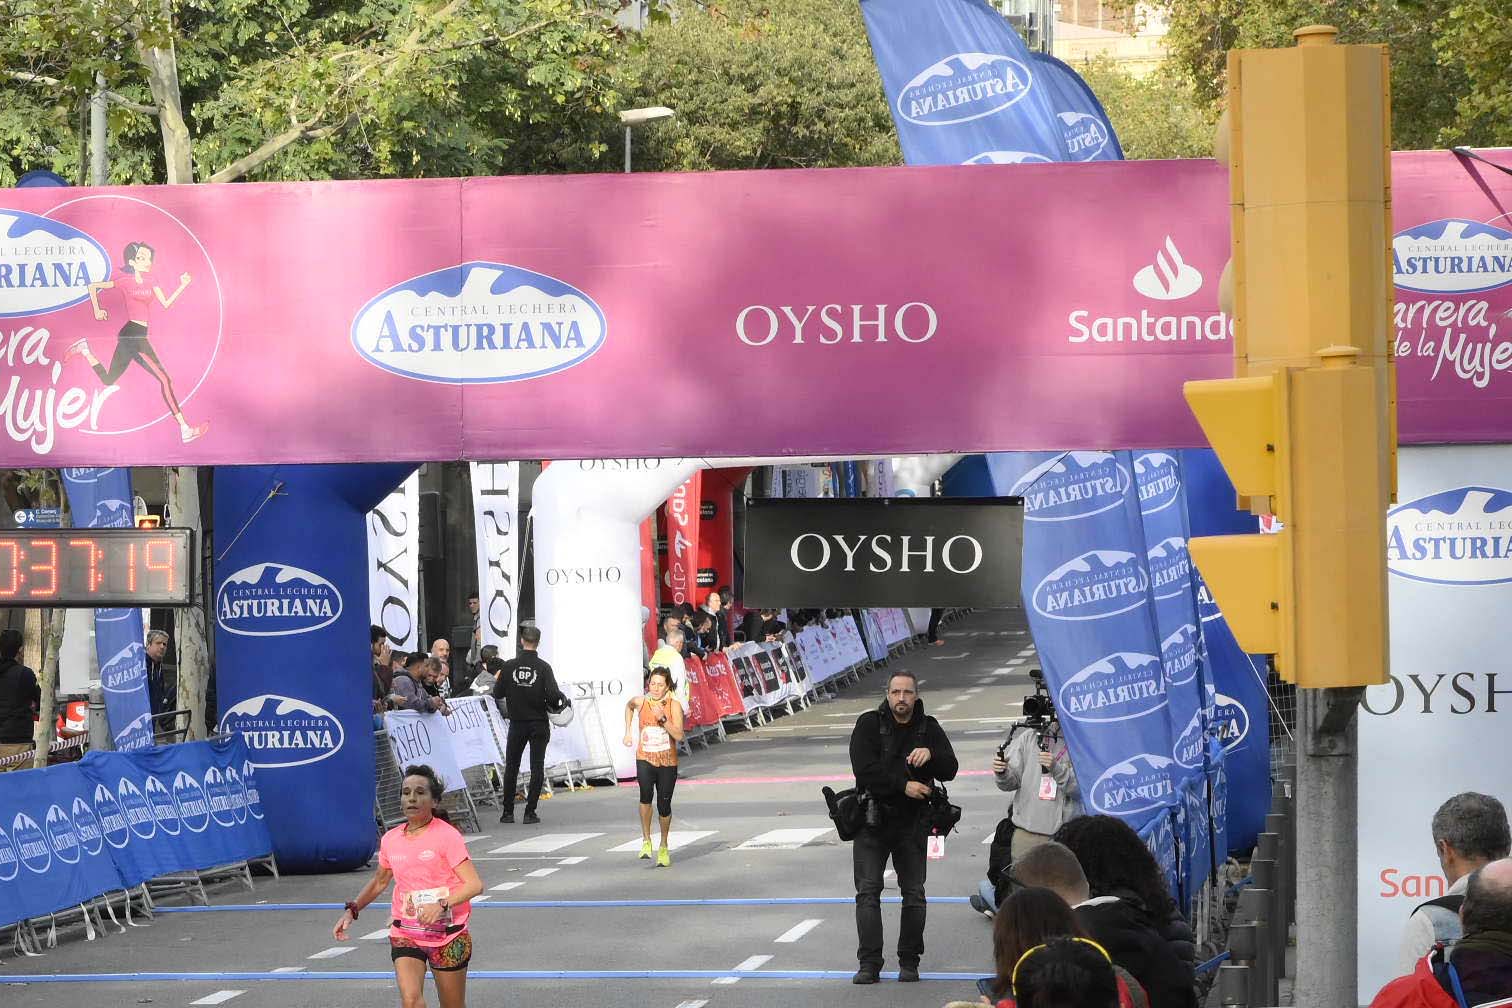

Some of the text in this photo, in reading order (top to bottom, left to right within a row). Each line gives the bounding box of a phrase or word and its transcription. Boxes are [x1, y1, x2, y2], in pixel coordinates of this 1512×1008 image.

[13, 245, 87, 257] LECHERA
[1408, 244, 1458, 253] CENTRAL
[410, 302, 578, 317] CENTRAL LECHERA
[1394, 300, 1489, 328] arrera
[371, 310, 585, 353] ASTURIANA
[735, 302, 937, 345] OYSHO
[1417, 329, 1435, 357] la
[1415, 521, 1482, 531] CENTRAL
[790, 533, 984, 574] OYSHO
[546, 567, 621, 585] OYSHO
[233, 587, 328, 596] CENTRAL LECHERA
[221, 592, 333, 619] ASTURIANA
[519, 671, 531, 680] BP
[576, 680, 623, 697] SHO
[281, 719, 329, 727] LECHERA
[446, 699, 488, 734] OYSH
[219, 723, 334, 749] ATURIANA
[1380, 868, 1444, 898] San
